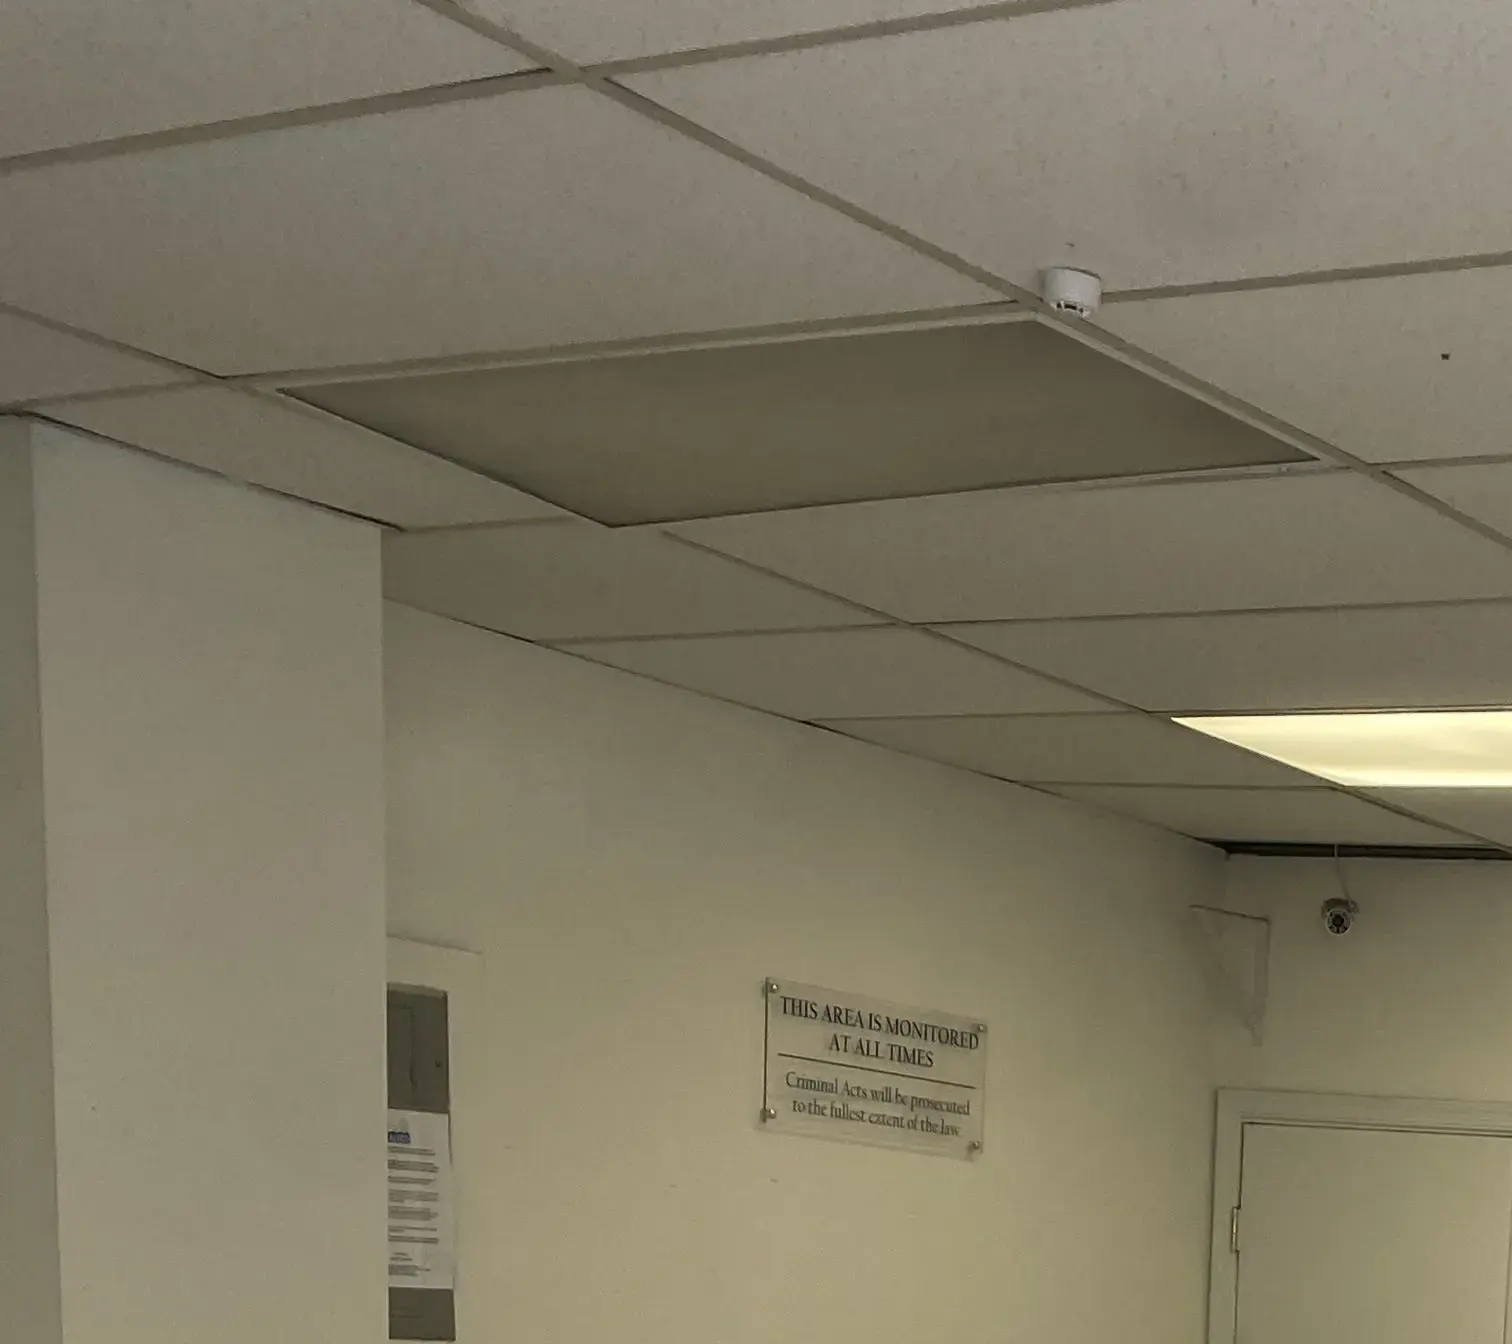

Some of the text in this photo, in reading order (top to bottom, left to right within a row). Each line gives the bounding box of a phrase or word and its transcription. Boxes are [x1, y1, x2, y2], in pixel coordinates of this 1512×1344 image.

[780, 996, 978, 1049] THIS AREA IS MONITORED
[829, 1033, 934, 1067] AT ALL TIMES
[786, 1072, 970, 1116] Criminal Acts will be prosecuted
[792, 1099, 805, 1113] to
[808, 1099, 827, 1117] the
[830, 1102, 865, 1122] fullest
[868, 1112, 905, 1128] extent
[907, 1113, 919, 1131] of
[920, 1115, 938, 1133] the
